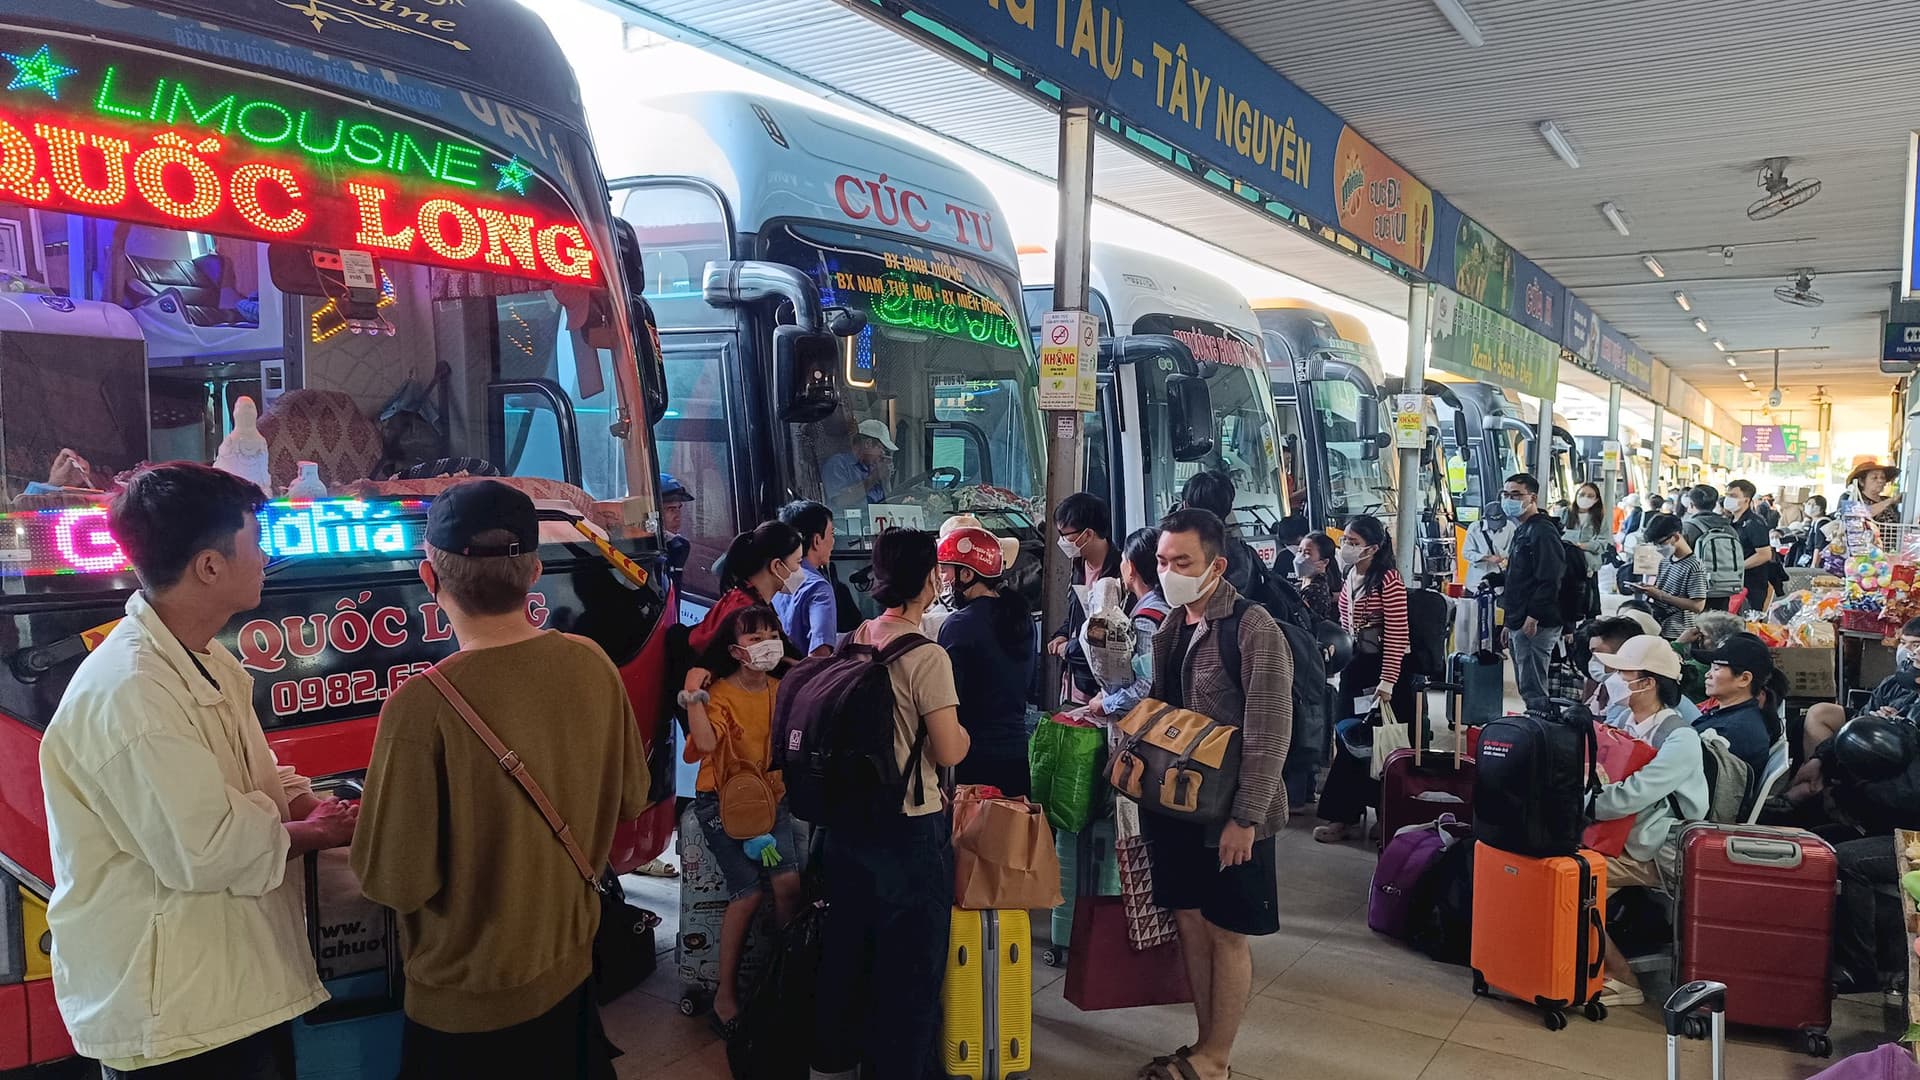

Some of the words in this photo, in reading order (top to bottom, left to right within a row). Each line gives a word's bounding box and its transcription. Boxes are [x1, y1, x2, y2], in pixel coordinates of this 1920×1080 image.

[97, 65, 482, 186] LIMOUSINE
[1152, 41, 1211, 130] TÂY
[1215, 85, 1311, 189] NGUYÊN
[349, 183, 593, 279] LONG
[834, 173, 931, 233] CÚC
[945, 203, 994, 252] TƯ
[836, 272, 855, 291] BX
[857, 275, 884, 294] NAM
[887, 280, 908, 299] TUY
[942, 289, 955, 305] BX
[883, 252, 900, 270] BX
[1044, 349, 1075, 367] KHÔNG
[1471, 343, 1492, 371] Xanh
[238, 591, 408, 672] QUỐC
[419, 592, 550, 643] LG
